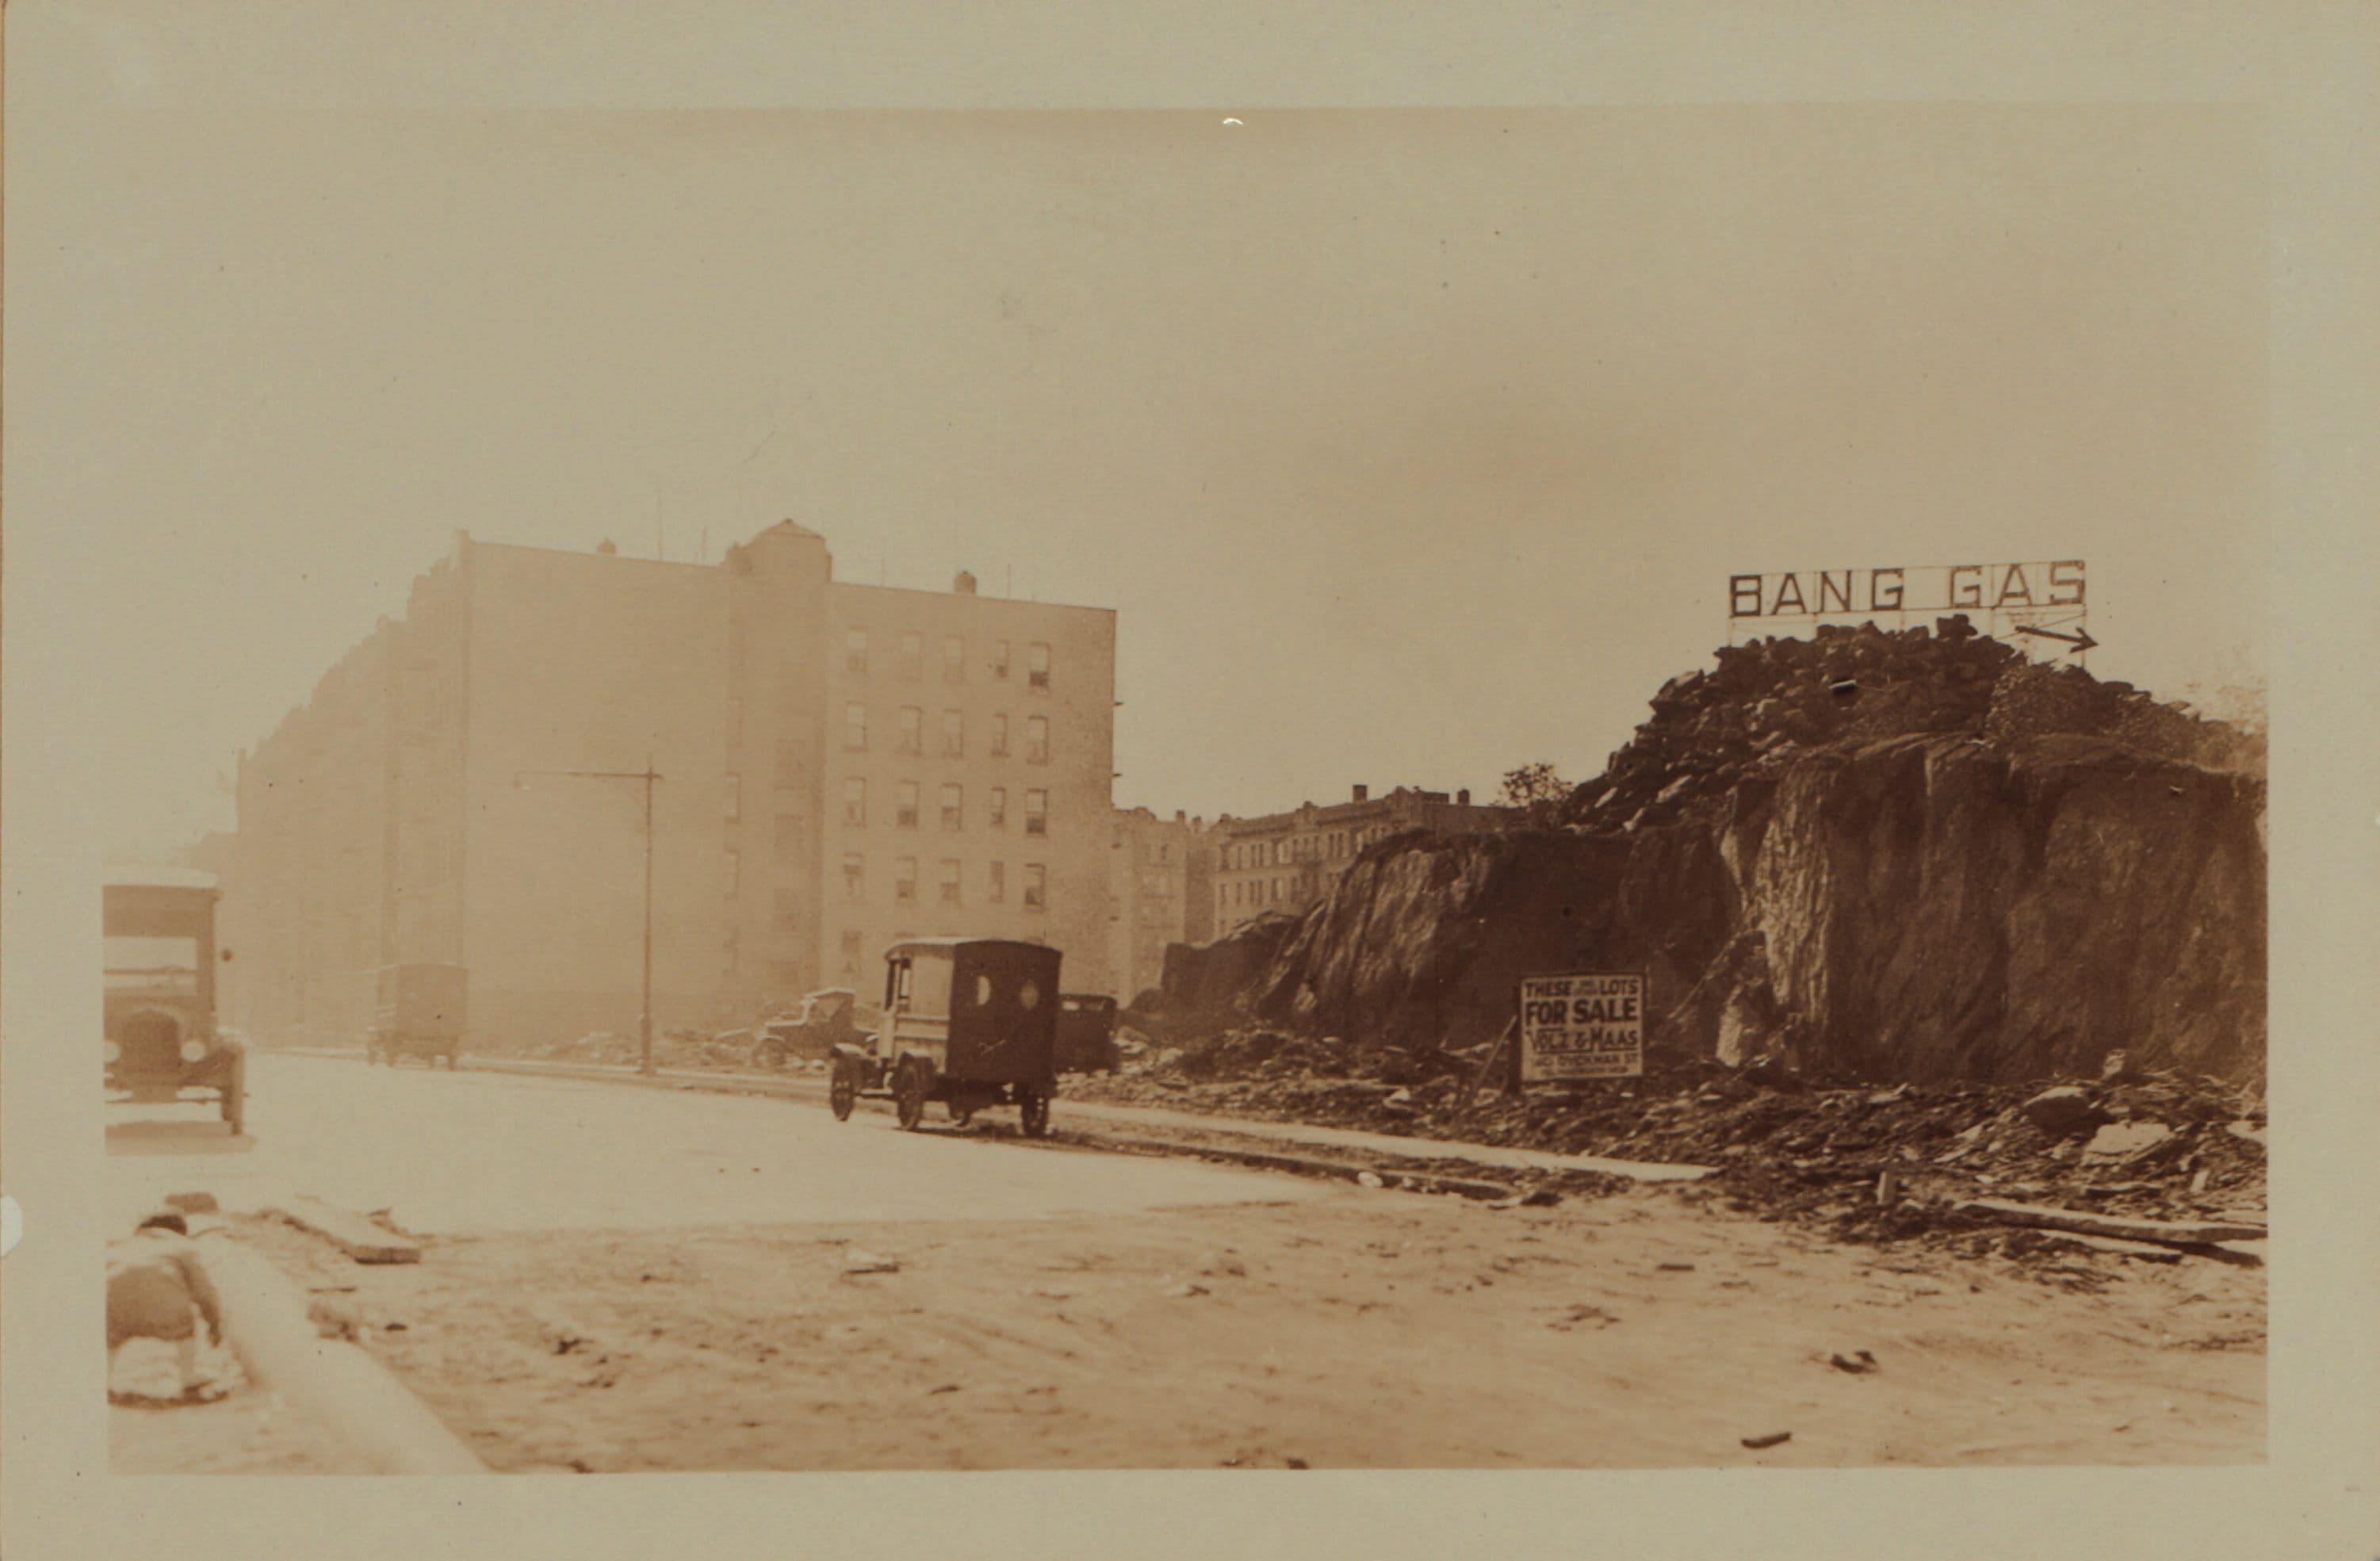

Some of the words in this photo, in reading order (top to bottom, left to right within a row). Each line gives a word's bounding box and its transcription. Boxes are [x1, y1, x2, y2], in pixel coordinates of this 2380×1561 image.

[1730, 568, 1904, 617] BANG
[1950, 560, 2085, 609] GAS
[1525, 981, 1573, 997] THESE
[1600, 978, 1638, 995] LOTS
[1525, 1000, 1567, 1027] FOR
[1573, 998, 1638, 1024] SALE
[1590, 1027, 1638, 1050] MAAS
